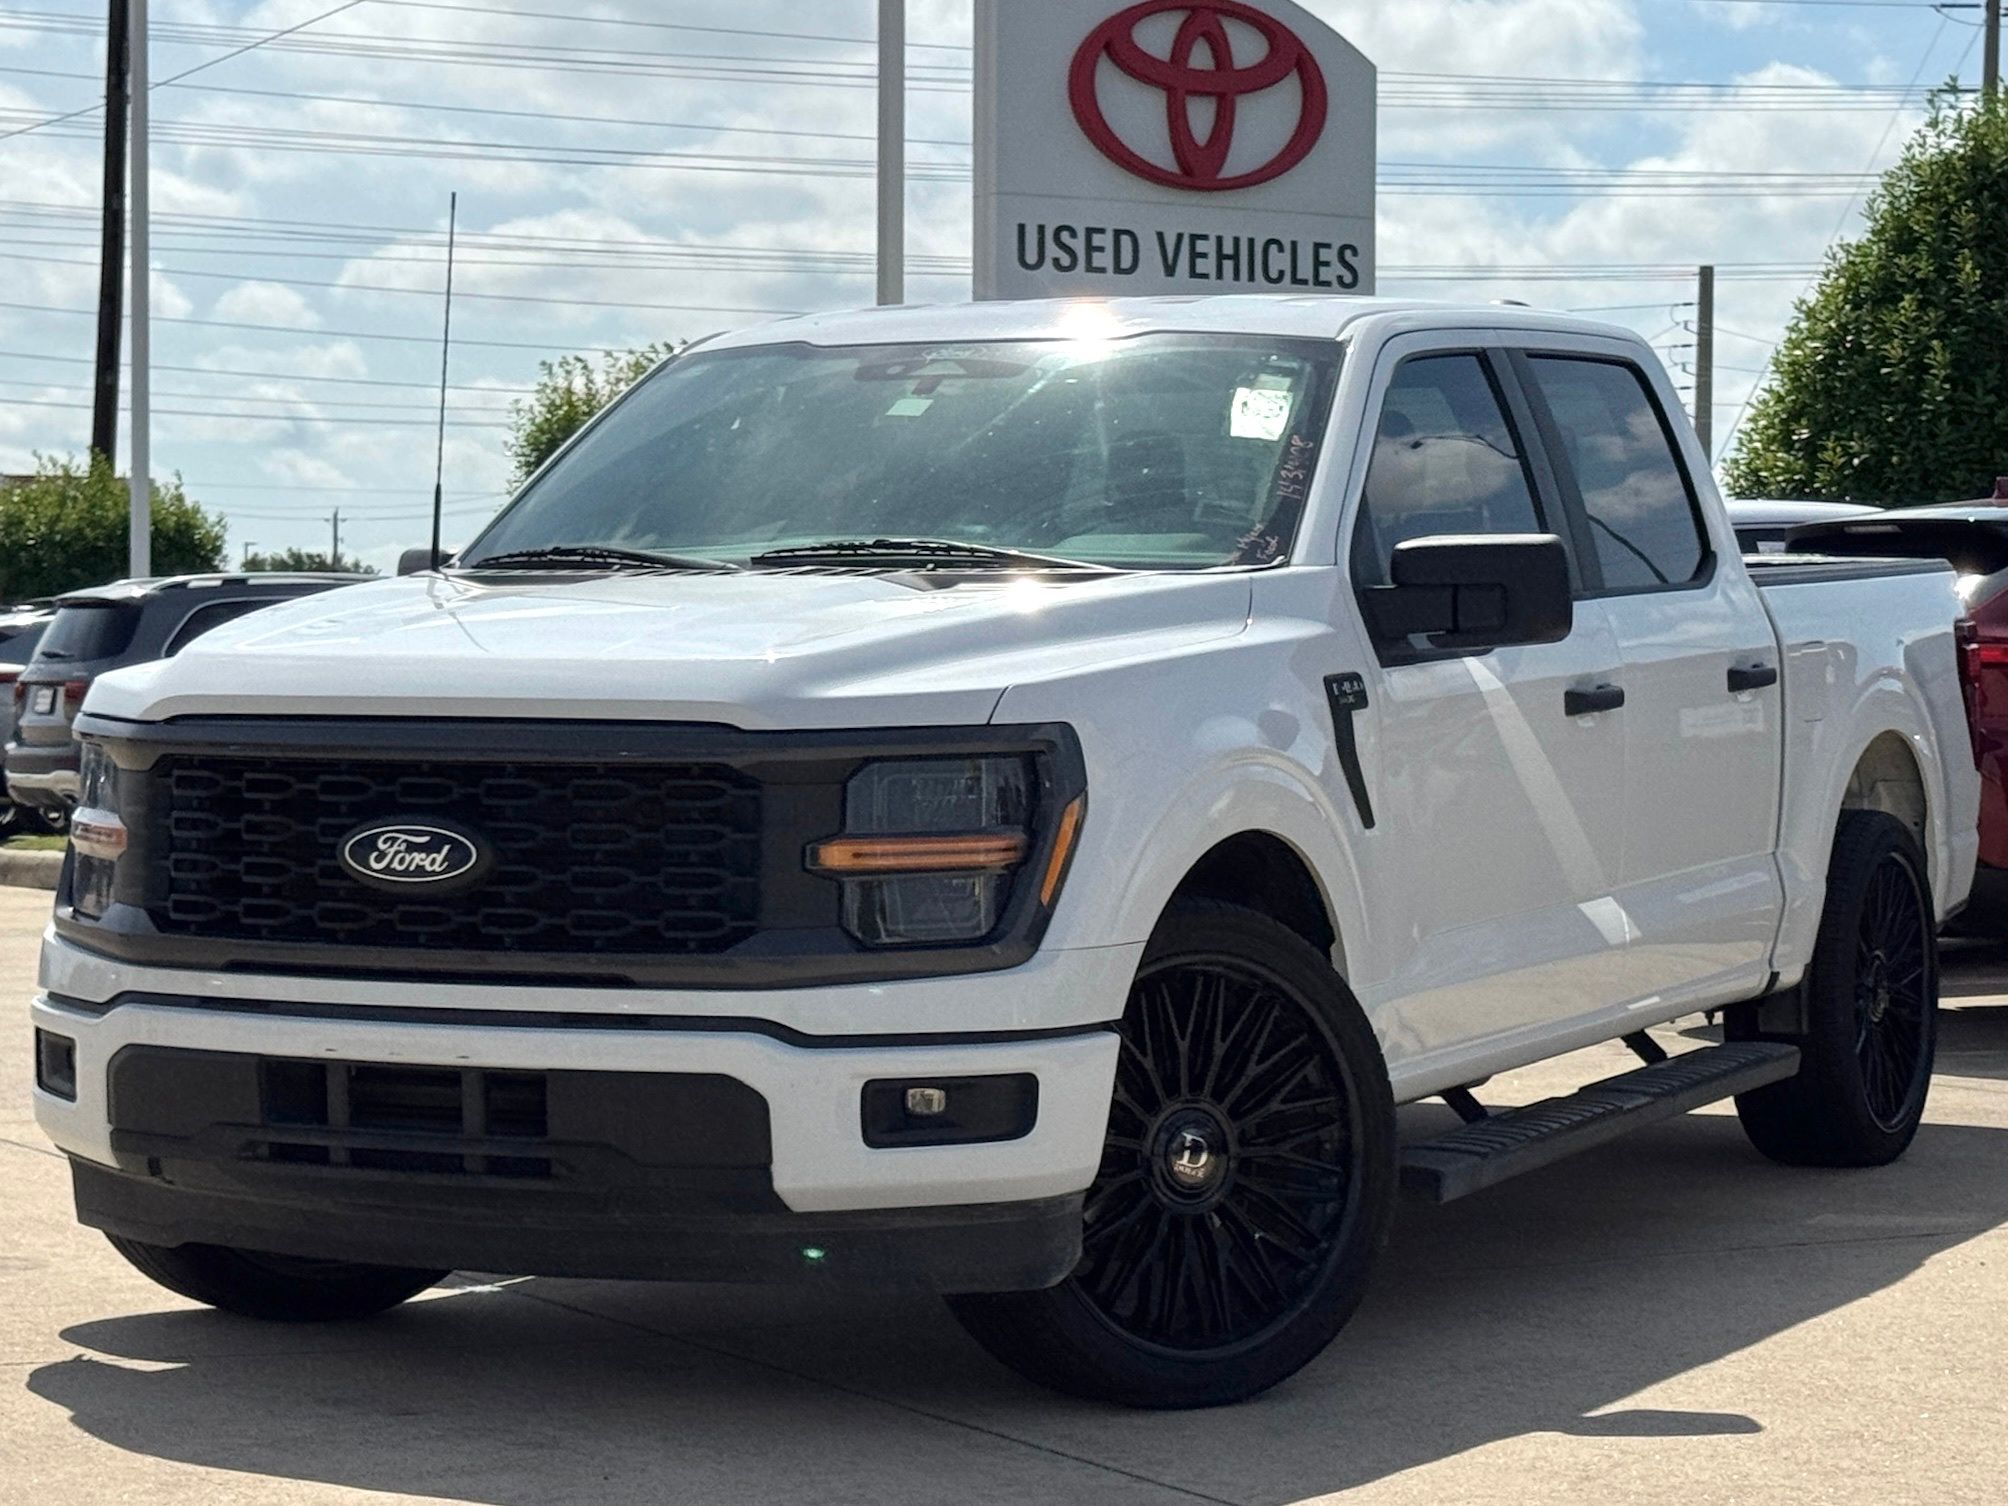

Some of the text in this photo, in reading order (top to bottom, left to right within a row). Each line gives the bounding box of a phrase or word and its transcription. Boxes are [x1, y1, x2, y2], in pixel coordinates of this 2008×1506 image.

[1016, 222, 1360, 289] USED VEHICLES
[369, 832, 452, 873] Ford
[1176, 1132, 1209, 1168] D
